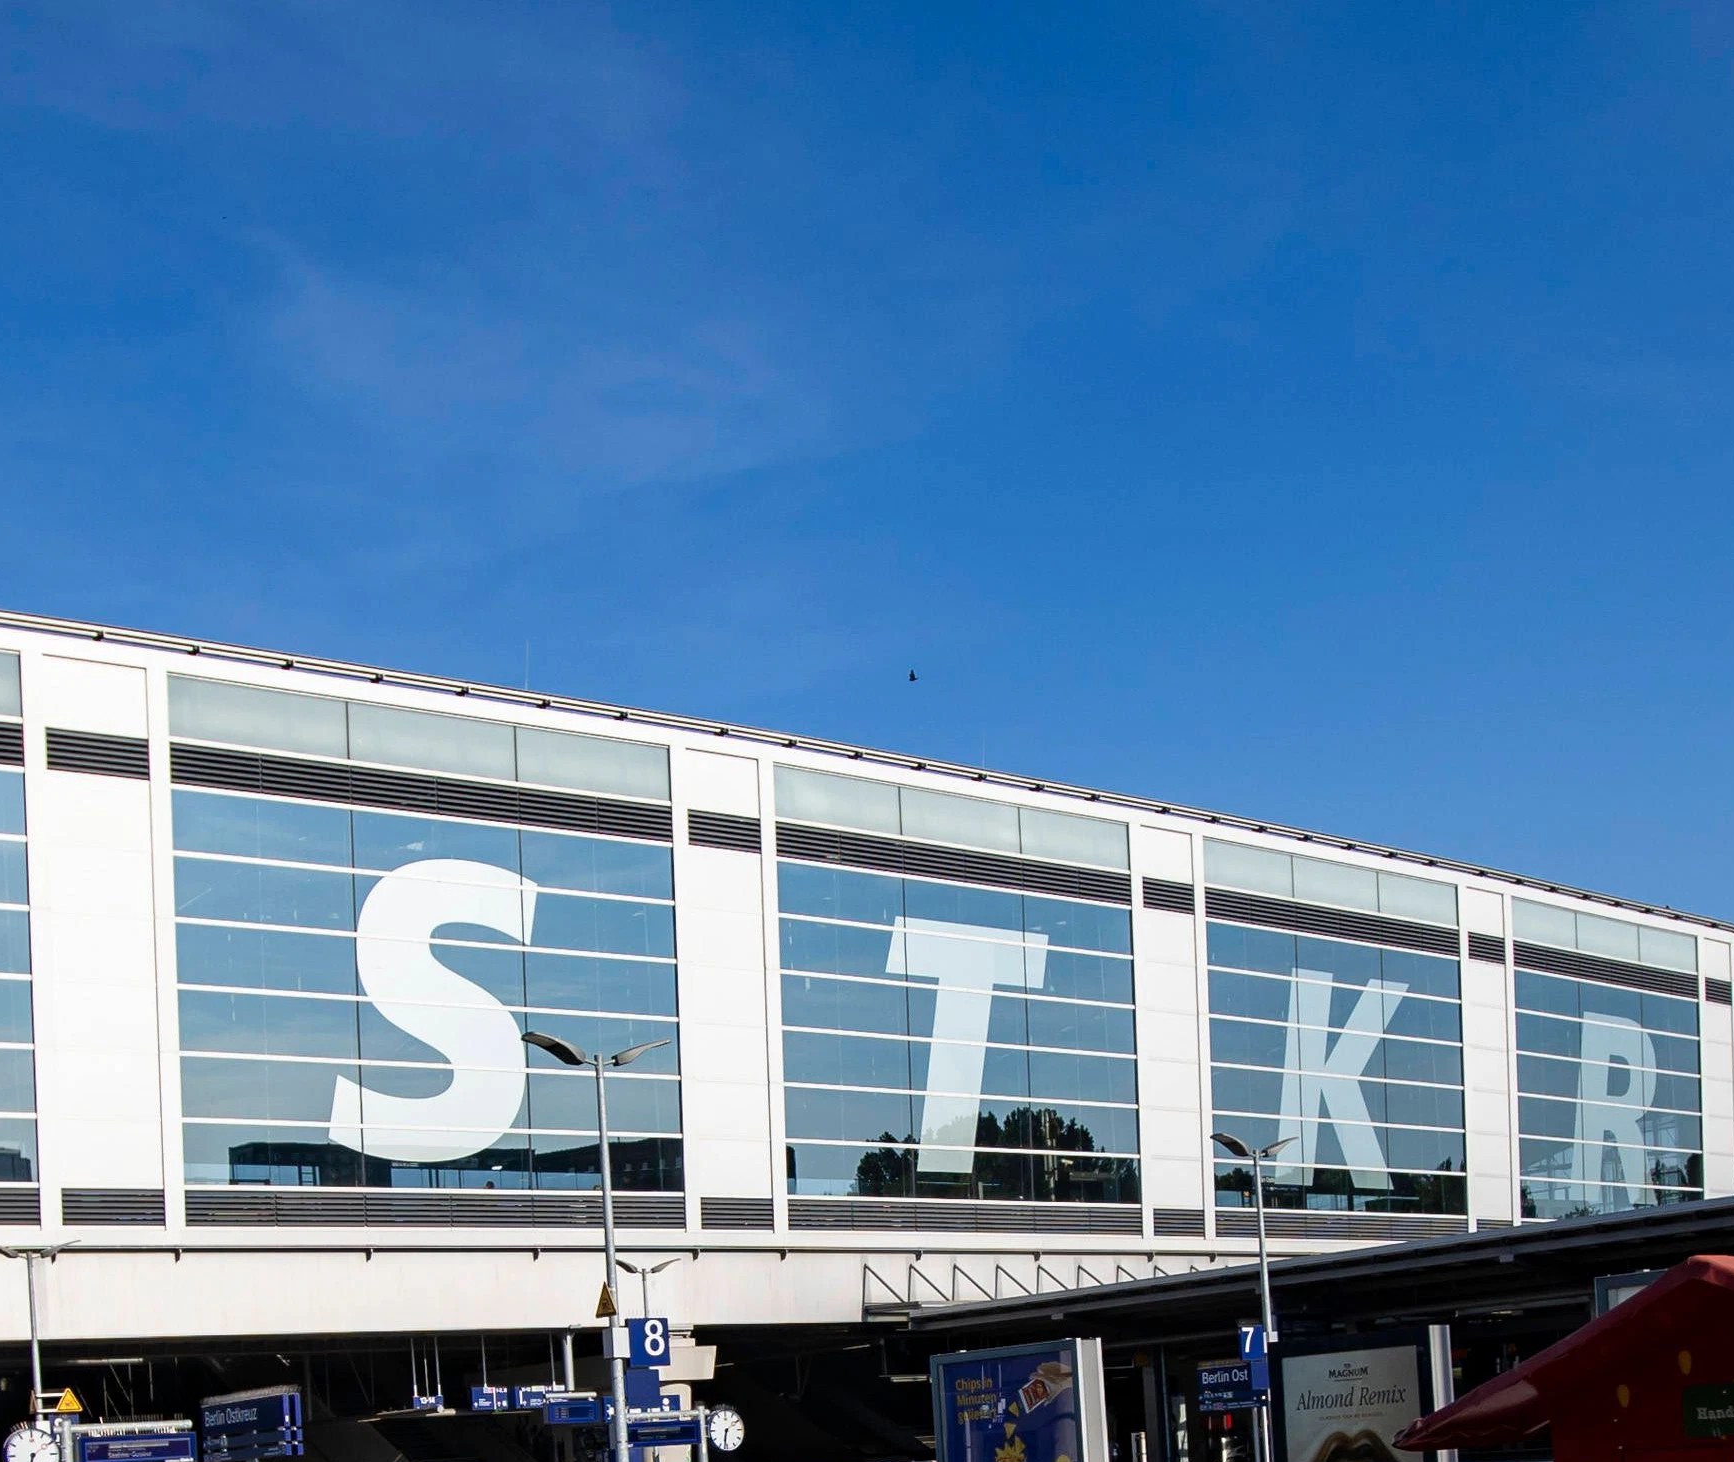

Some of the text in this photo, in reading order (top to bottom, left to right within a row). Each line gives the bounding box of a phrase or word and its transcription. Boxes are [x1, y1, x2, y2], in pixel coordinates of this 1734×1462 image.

[643, 1320, 665, 1357] 8
[1241, 1326, 1255, 1353] 7
[1201, 1371, 1230, 1385] Berlin
[1328, 1366, 1369, 1379] MAGNUM
[1296, 1384, 1407, 1411] Almond Remix
[204, 1407, 258, 1427] Berlin Ostkreuz
